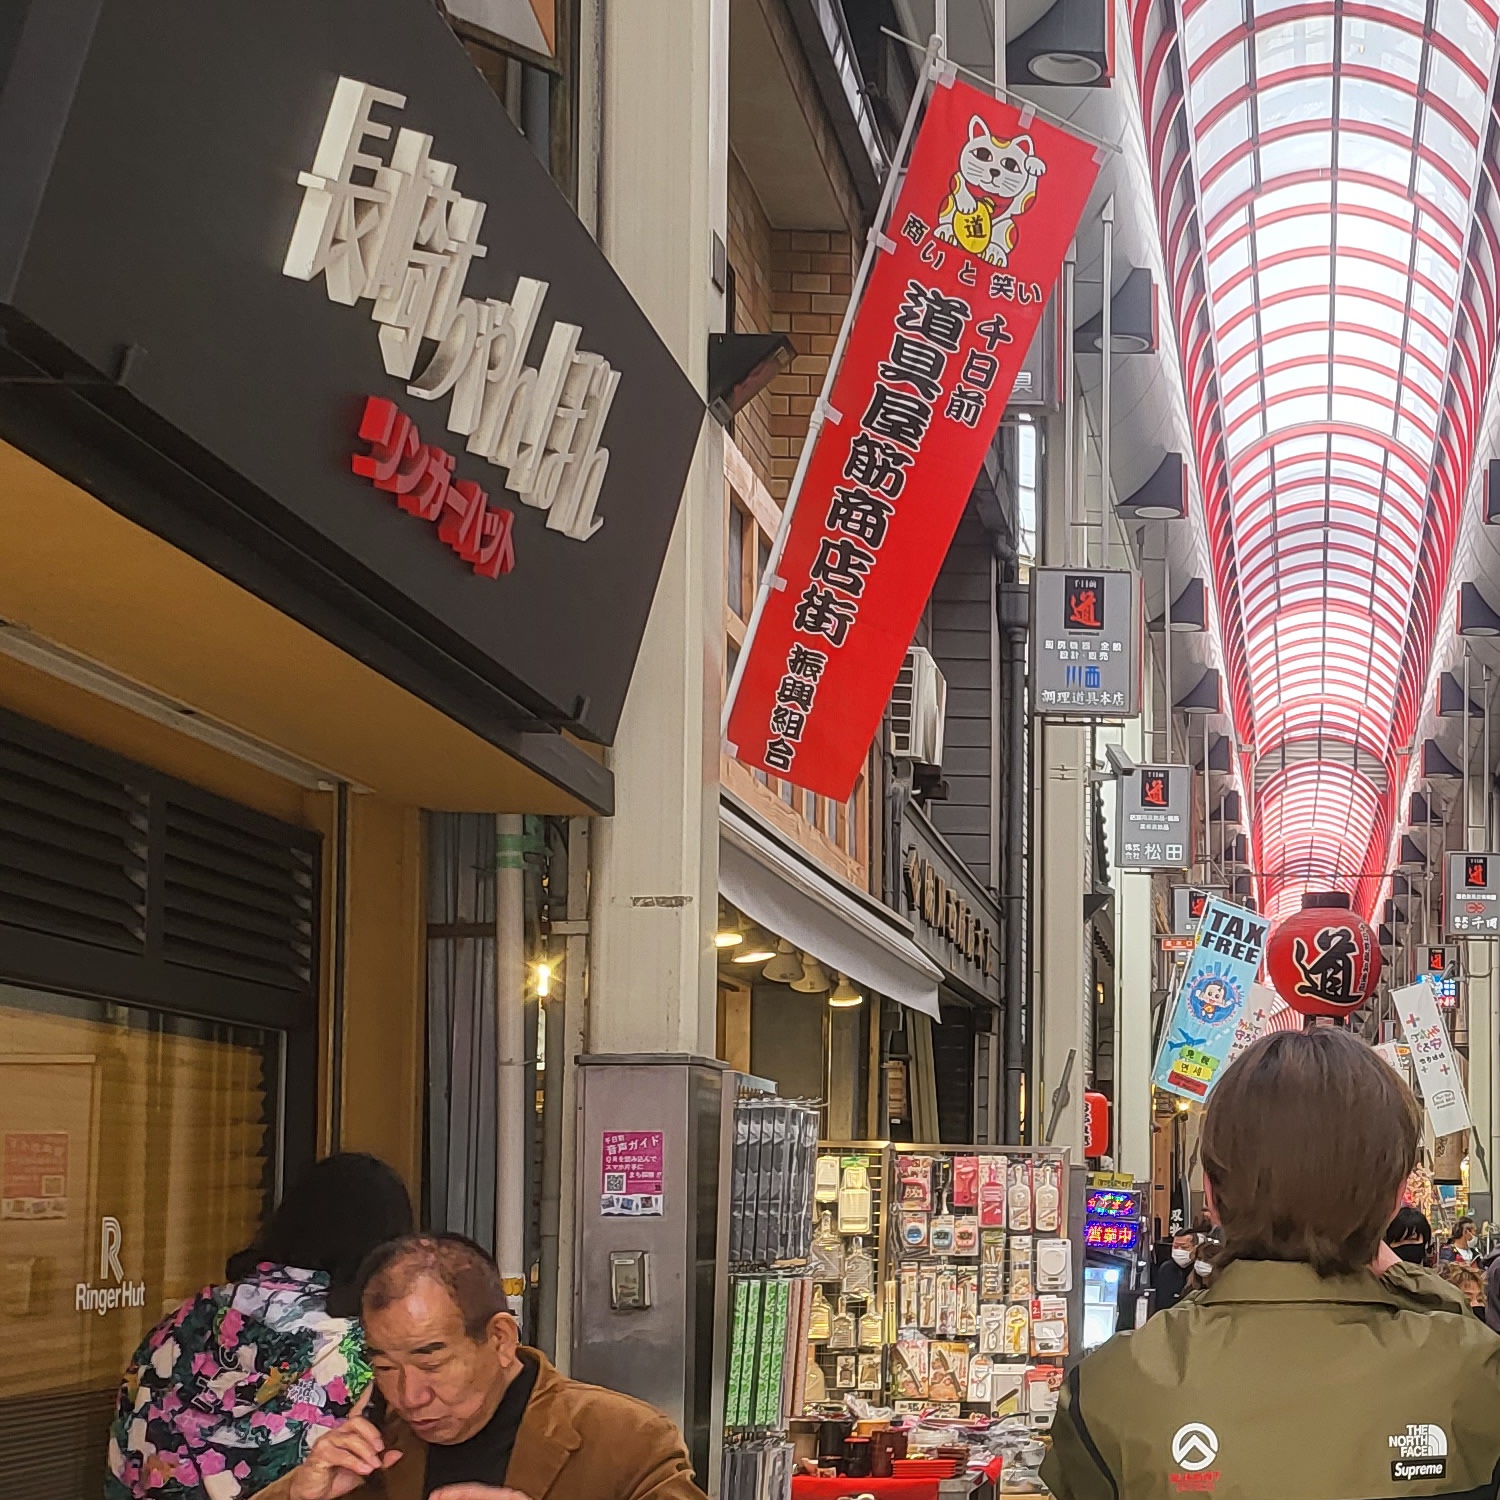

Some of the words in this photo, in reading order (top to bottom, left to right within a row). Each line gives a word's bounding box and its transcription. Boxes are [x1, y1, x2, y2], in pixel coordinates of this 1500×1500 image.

[963, 215, 987, 239] 道
[283, 75, 622, 541] 長崎ちゃんぽん
[944, 314, 1014, 429] 千日前
[793, 279, 973, 649] 道具屋筋商店街
[351, 395, 515, 580] リンガーハット
[1070, 590, 1101, 627] 道
[1066, 665, 1101, 688] 川西
[763, 643, 829, 774] 振興組合
[1041, 690, 1125, 707] 調理道具本店
[1144, 843, 1182, 861] 松田
[1211, 908, 1267, 948] TAX
[1201, 931, 1260, 965] FREE
[1293, 926, 1364, 1006] 道
[606, 1135, 660, 1155] 音声ガイド
[1388, 1434, 1428, 1447] NORTH
[1405, 1424, 1429, 1436] THE
[1400, 1446, 1428, 1458] FACE
[1394, 1462, 1443, 1480] Supreme
